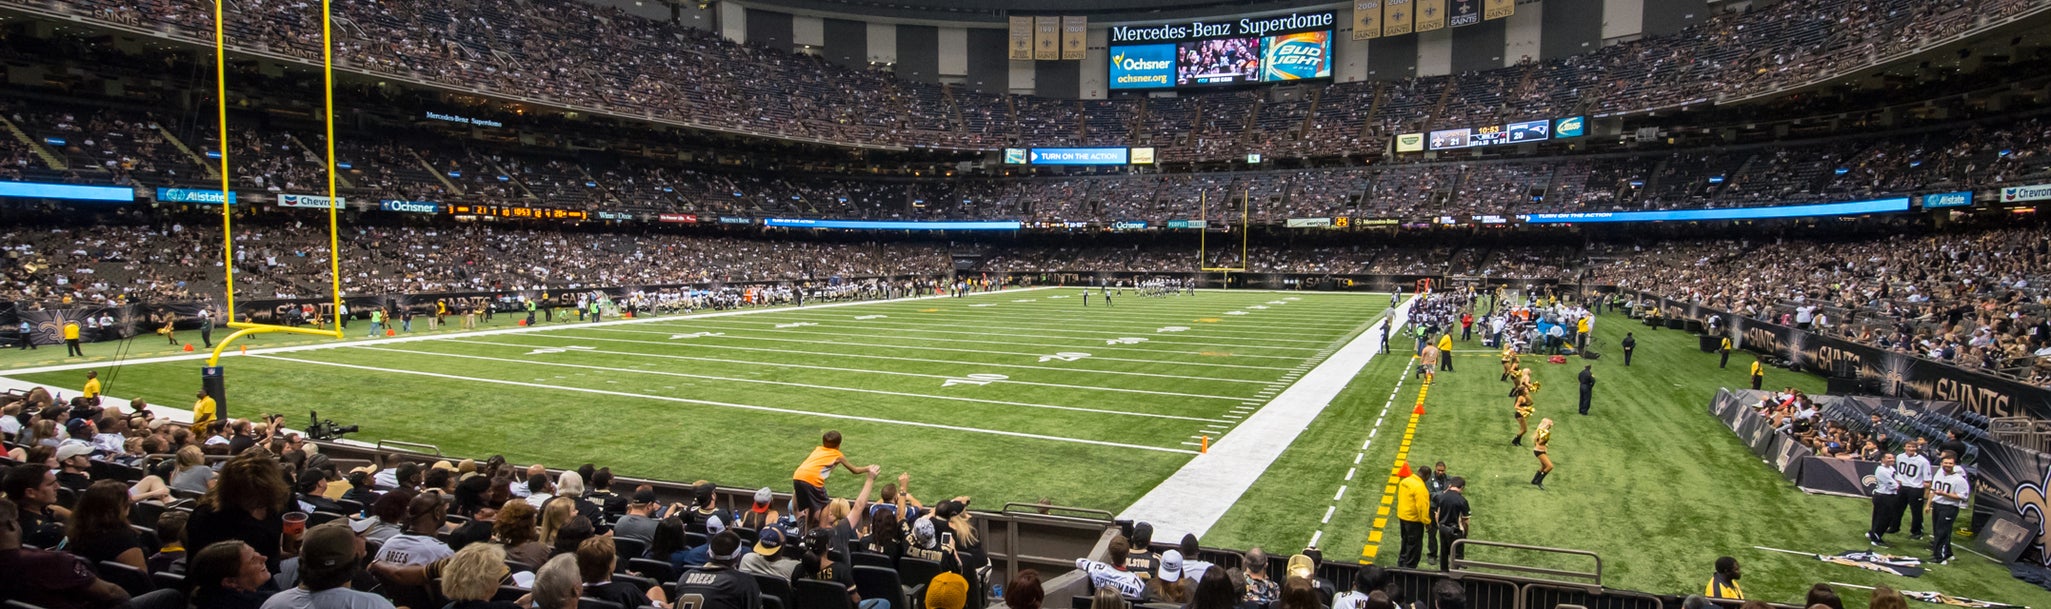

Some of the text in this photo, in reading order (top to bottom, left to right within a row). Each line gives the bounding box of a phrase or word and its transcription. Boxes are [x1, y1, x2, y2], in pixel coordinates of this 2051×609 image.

[95, 10, 139, 25] SAINTS
[1451, 16, 1477, 26] SAINTS
[1112, 13, 1332, 41] Mercedes-Benz Superdome
[198, 30, 236, 45] SAITS
[284, 47, 318, 59] SAINTS
[1279, 45, 1321, 56] BUD
[1124, 58, 1170, 70] Ochsner
[1272, 55, 1322, 66] LIGHT
[1118, 74, 1167, 84] ochsner.org
[1479, 126, 1499, 134] 10:53
[1514, 132, 1524, 140] 20
[391, 201, 434, 212] Ochsner
[1116, 221, 1144, 229] Ochsner
[1337, 217, 1347, 226] 25
[1749, 326, 1776, 353] SAINTS
[1936, 377, 2009, 419] SAINTS
[1898, 461, 1918, 478] 00
[685, 573, 716, 584] BREES
